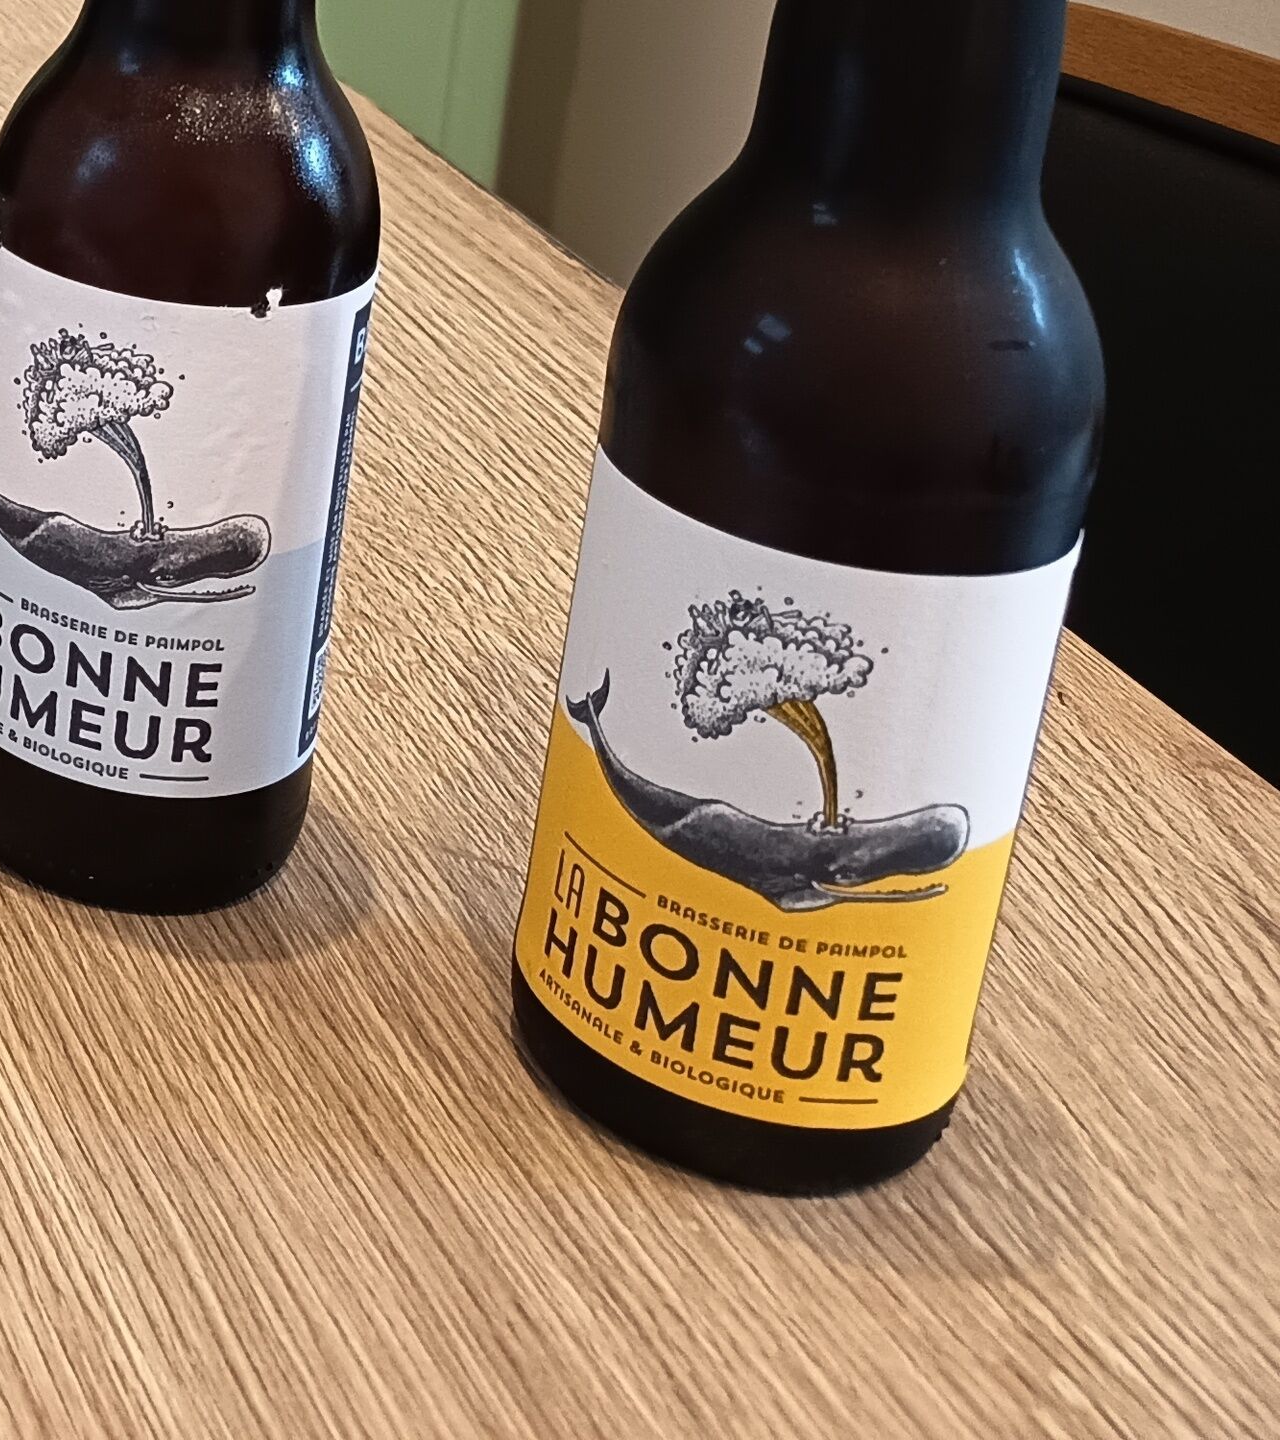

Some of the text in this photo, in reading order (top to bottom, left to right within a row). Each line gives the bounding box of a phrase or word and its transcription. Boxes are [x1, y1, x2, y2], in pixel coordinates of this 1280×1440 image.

[20, 597, 225, 652] BRASSERIE DE PAIMPOL
[7, 728, 19, 743] &
[23, 735, 129, 780] BIOLOGIQUE
[553, 848, 585, 919] LA
[592, 886, 903, 1022] BONNE
[655, 894, 908, 961] BRASSERIE DE PAIMPOL
[543, 907, 886, 1084] HUMEUR
[539, 968, 786, 1105] ARTISANALE & BIOLOGIQUE
